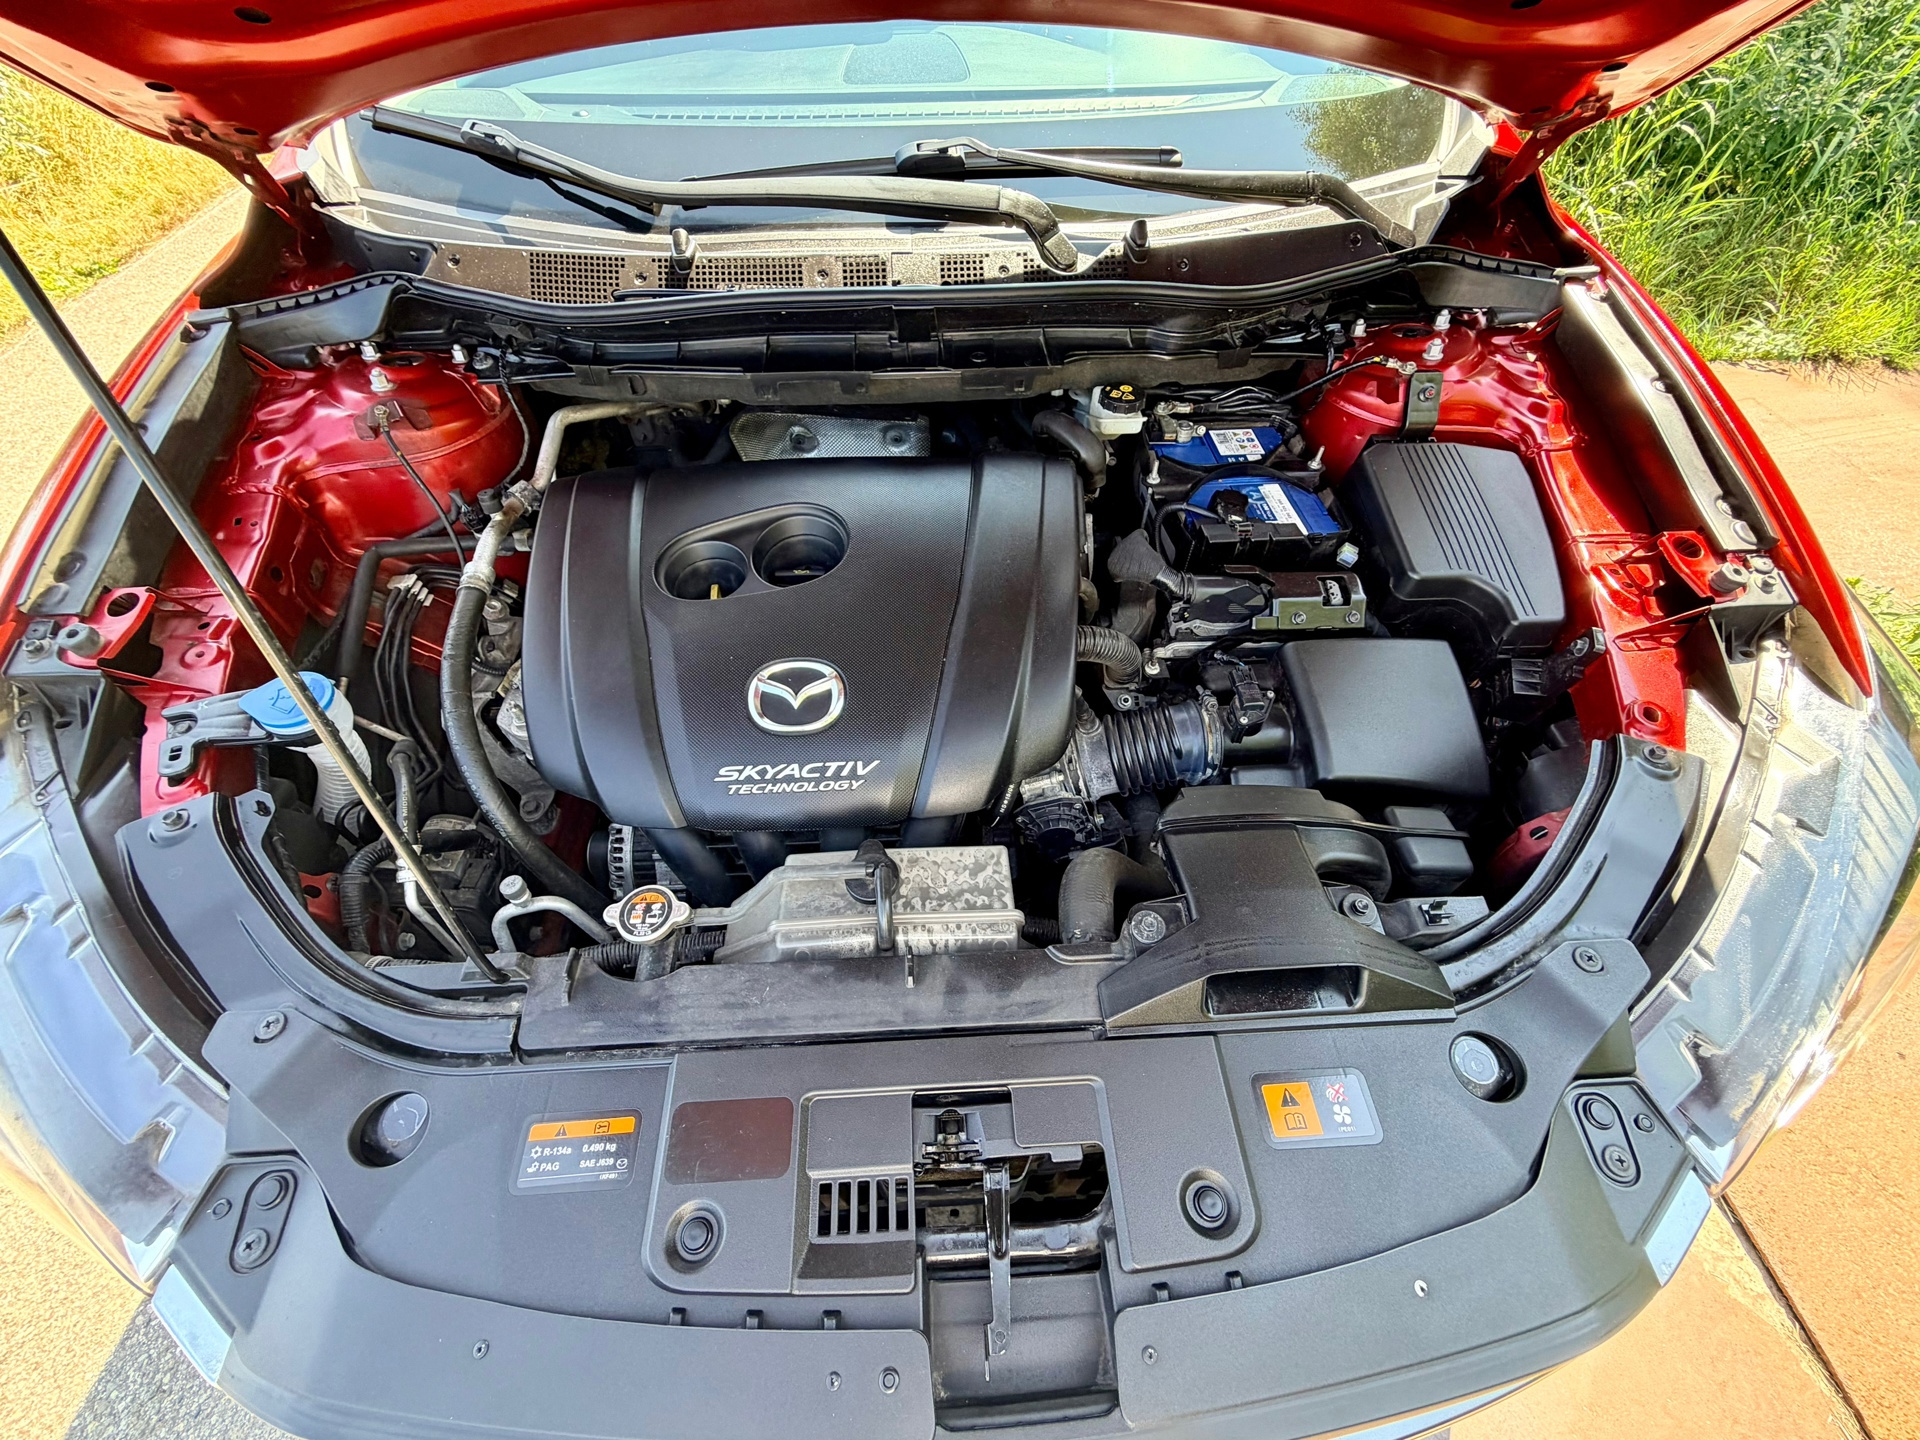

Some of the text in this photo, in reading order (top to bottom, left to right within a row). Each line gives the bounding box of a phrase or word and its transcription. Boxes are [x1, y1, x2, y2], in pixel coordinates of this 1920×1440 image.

[713, 760, 881, 782] SKYACTIV
[727, 780, 866, 795] TECHNOLOGY
[543, 1142, 617, 1157] R-134a 0.490 kg
[540, 1162, 560, 1172] PAG
[579, 1159, 596, 1168] SAE
